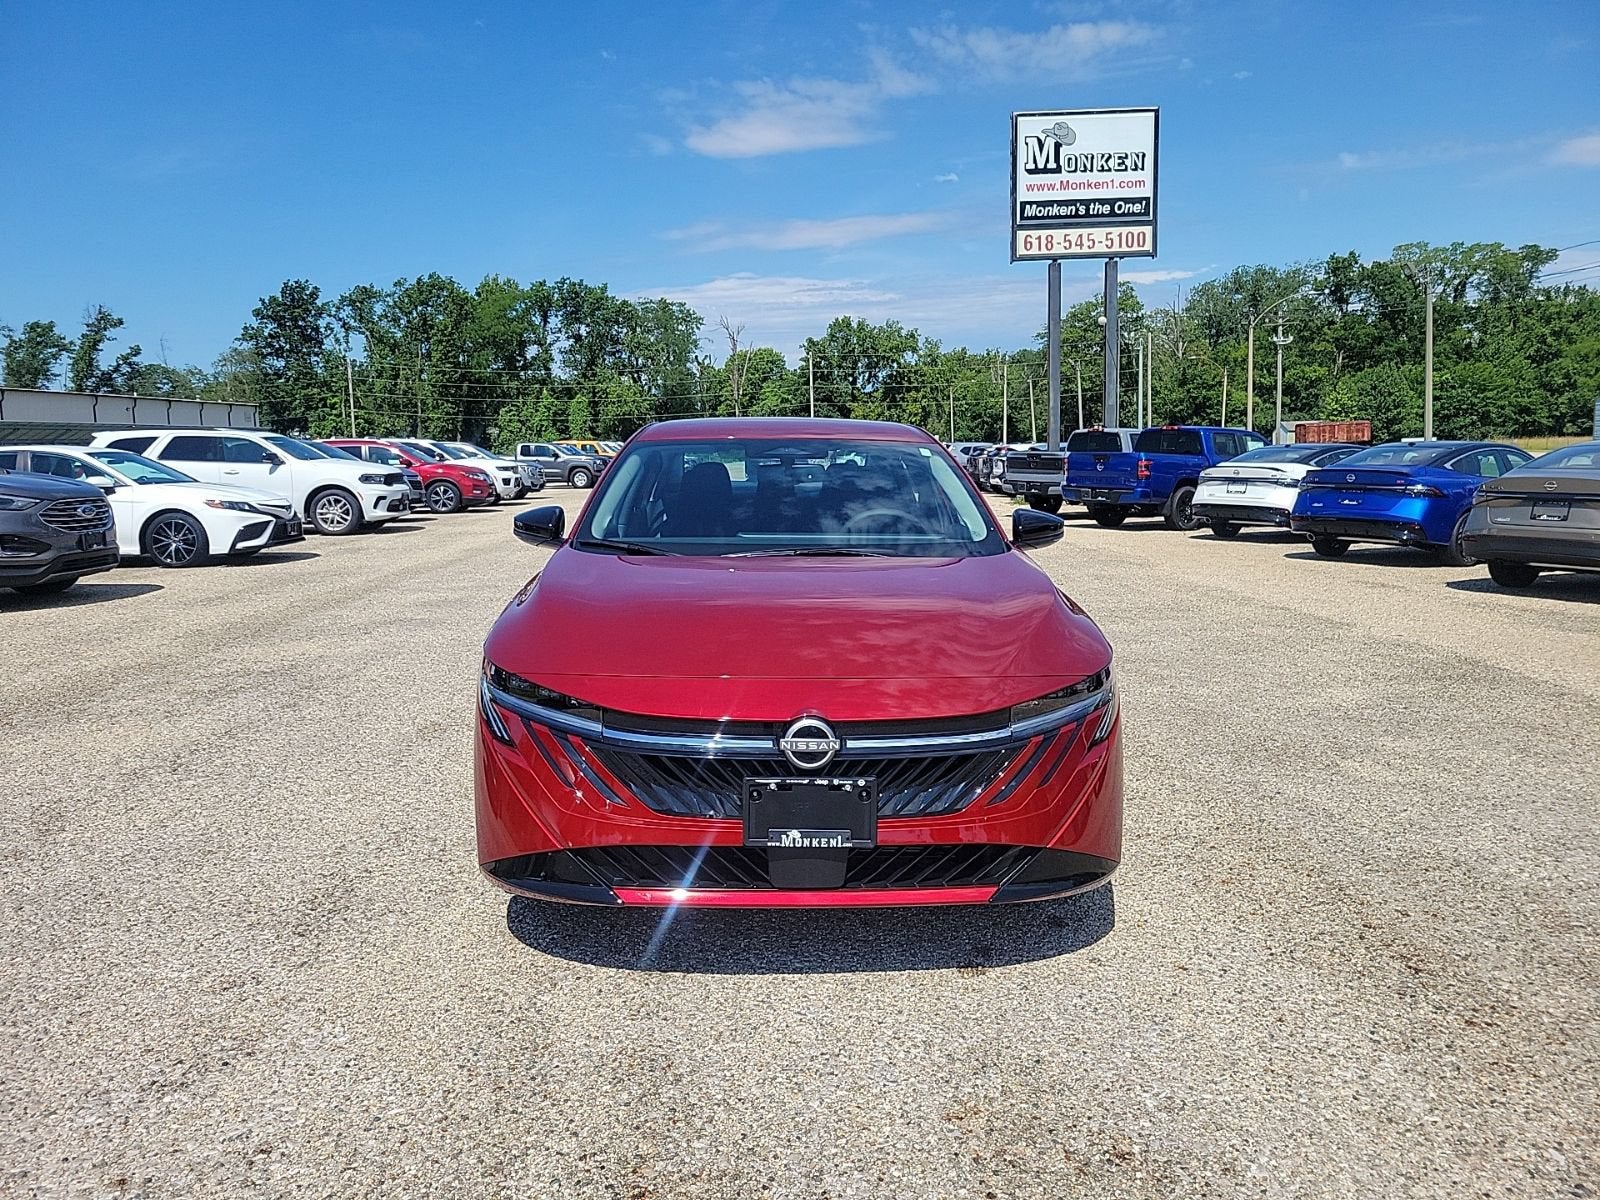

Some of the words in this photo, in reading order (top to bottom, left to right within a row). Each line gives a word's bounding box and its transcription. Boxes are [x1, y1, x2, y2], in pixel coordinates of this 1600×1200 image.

[1024, 135, 1146, 175] MONKEN
[1025, 178, 1146, 193] www.Monken1.com
[1023, 202, 1086, 217] Monken's
[1089, 201, 1111, 212] the
[1114, 200, 1146, 214] One!
[1023, 231, 1147, 252] 618-545-5100
[780, 740, 840, 750] NISSAN
